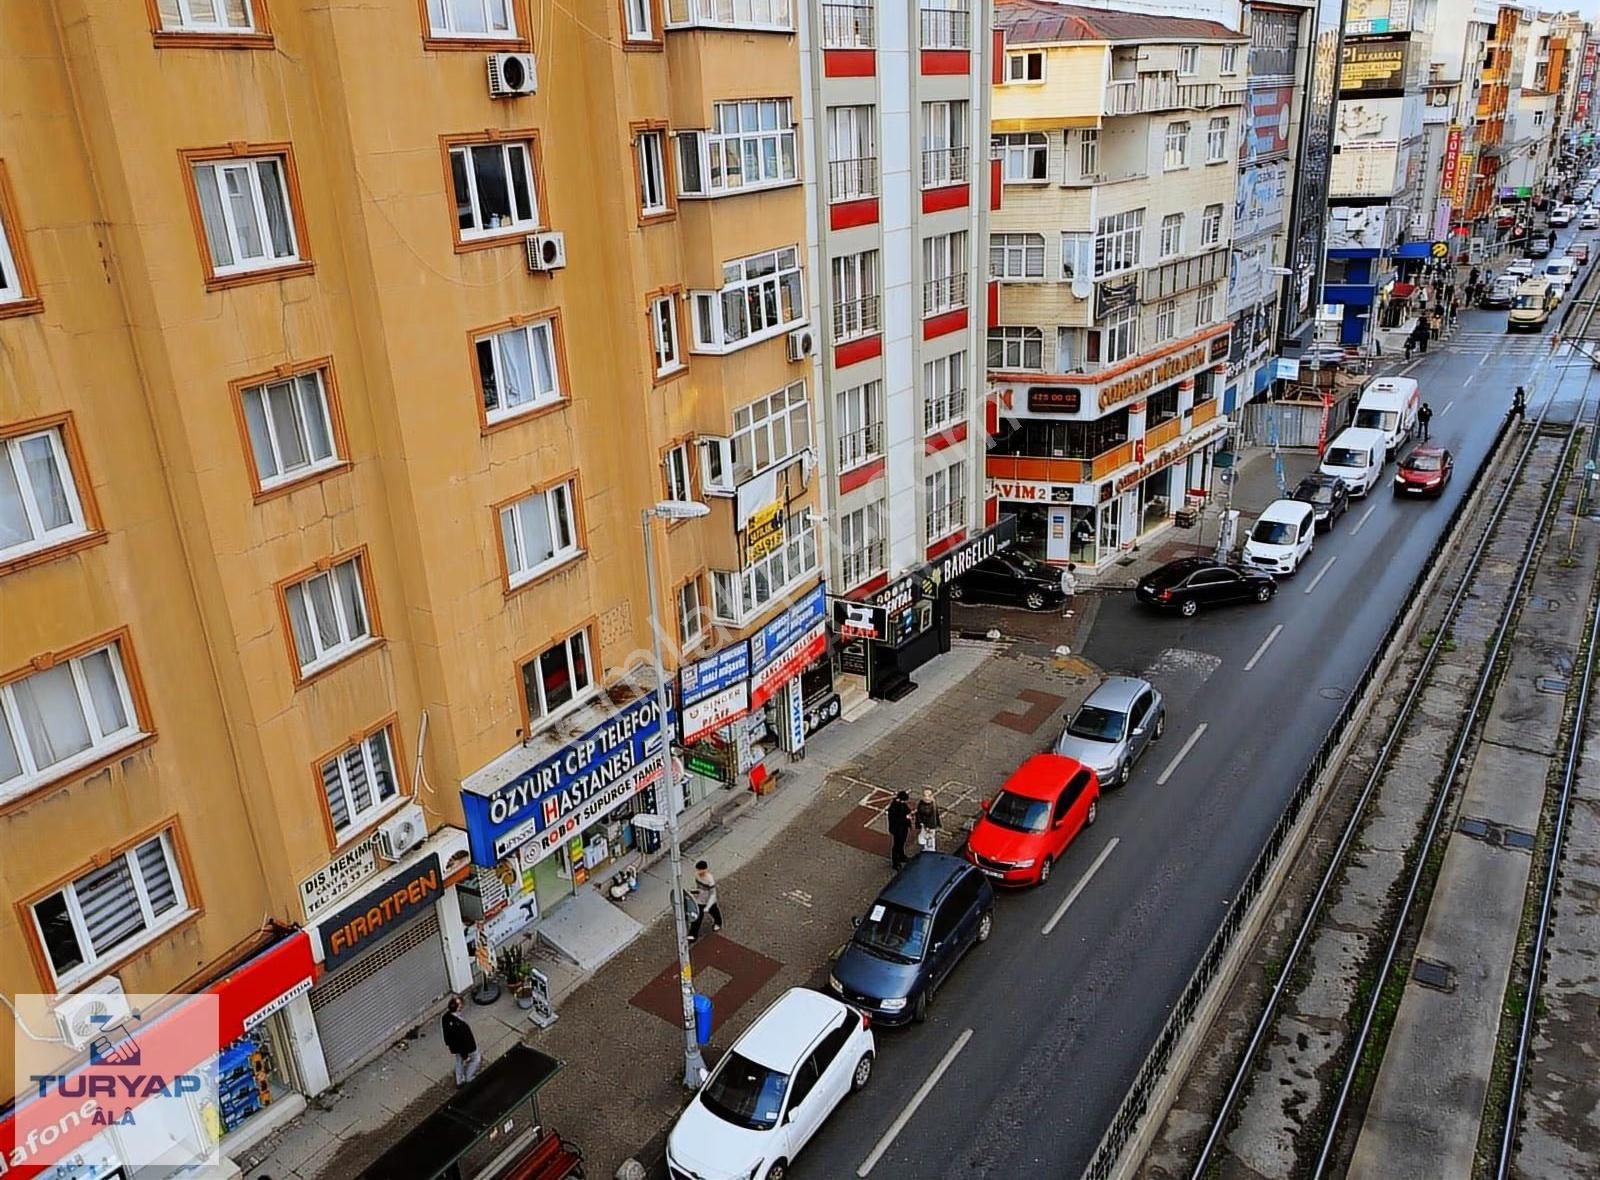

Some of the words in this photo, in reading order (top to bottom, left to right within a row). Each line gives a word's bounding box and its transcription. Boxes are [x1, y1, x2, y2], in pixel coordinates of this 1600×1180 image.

[1444, 131, 1459, 190] SOROCO
[944, 534, 995, 583] BARGELLO
[703, 688, 741, 711] SINGER
[490, 760, 561, 824] ÖZYURT
[565, 741, 596, 776] CEP
[599, 689, 674, 753] TELEFONU
[543, 741, 636, 825] HASTANESİ
[541, 814, 582, 851] ROBOT
[584, 780, 632, 820] SÜPÜRGE
[328, 869, 438, 957] FIRATPEN
